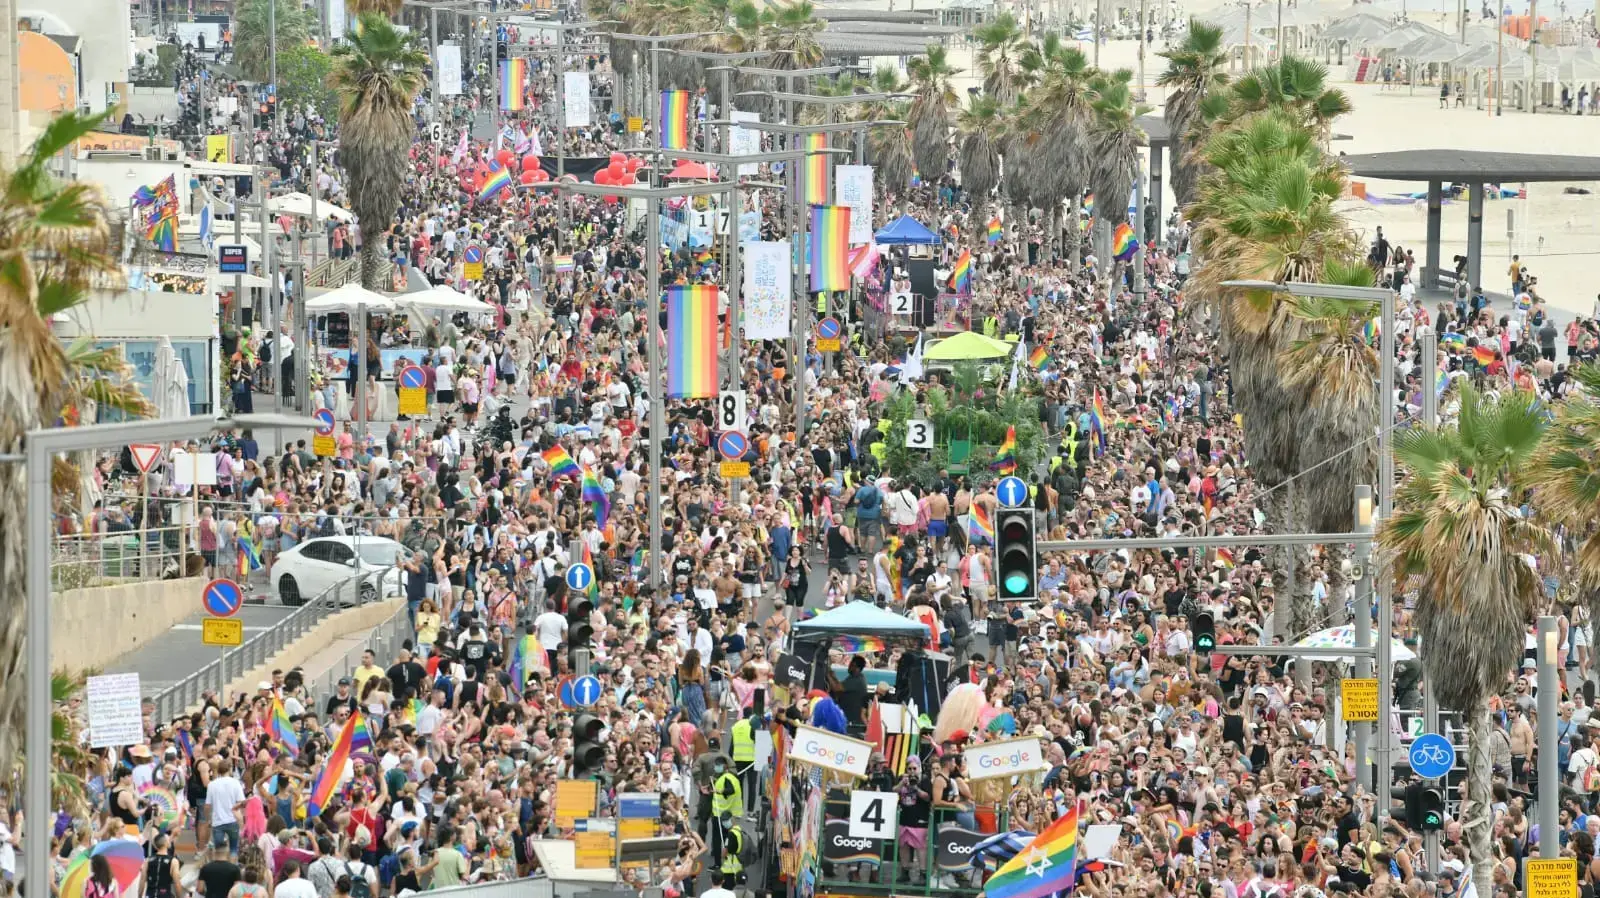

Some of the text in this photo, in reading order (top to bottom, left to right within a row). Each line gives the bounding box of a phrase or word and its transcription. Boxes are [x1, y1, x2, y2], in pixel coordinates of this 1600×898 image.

[434, 125, 439, 140] 6
[699, 214, 707, 227] 1
[721, 212, 729, 232] 7
[897, 296, 907, 311] 2
[723, 395, 736, 426] 8
[913, 424, 926, 444] 3
[1415, 719, 1423, 736] 2
[806, 740, 856, 766] Google
[979, 750, 1030, 769] Google
[861, 798, 885, 832] 4
[833, 835, 872, 850] Google
[948, 842, 972, 853] Goo
